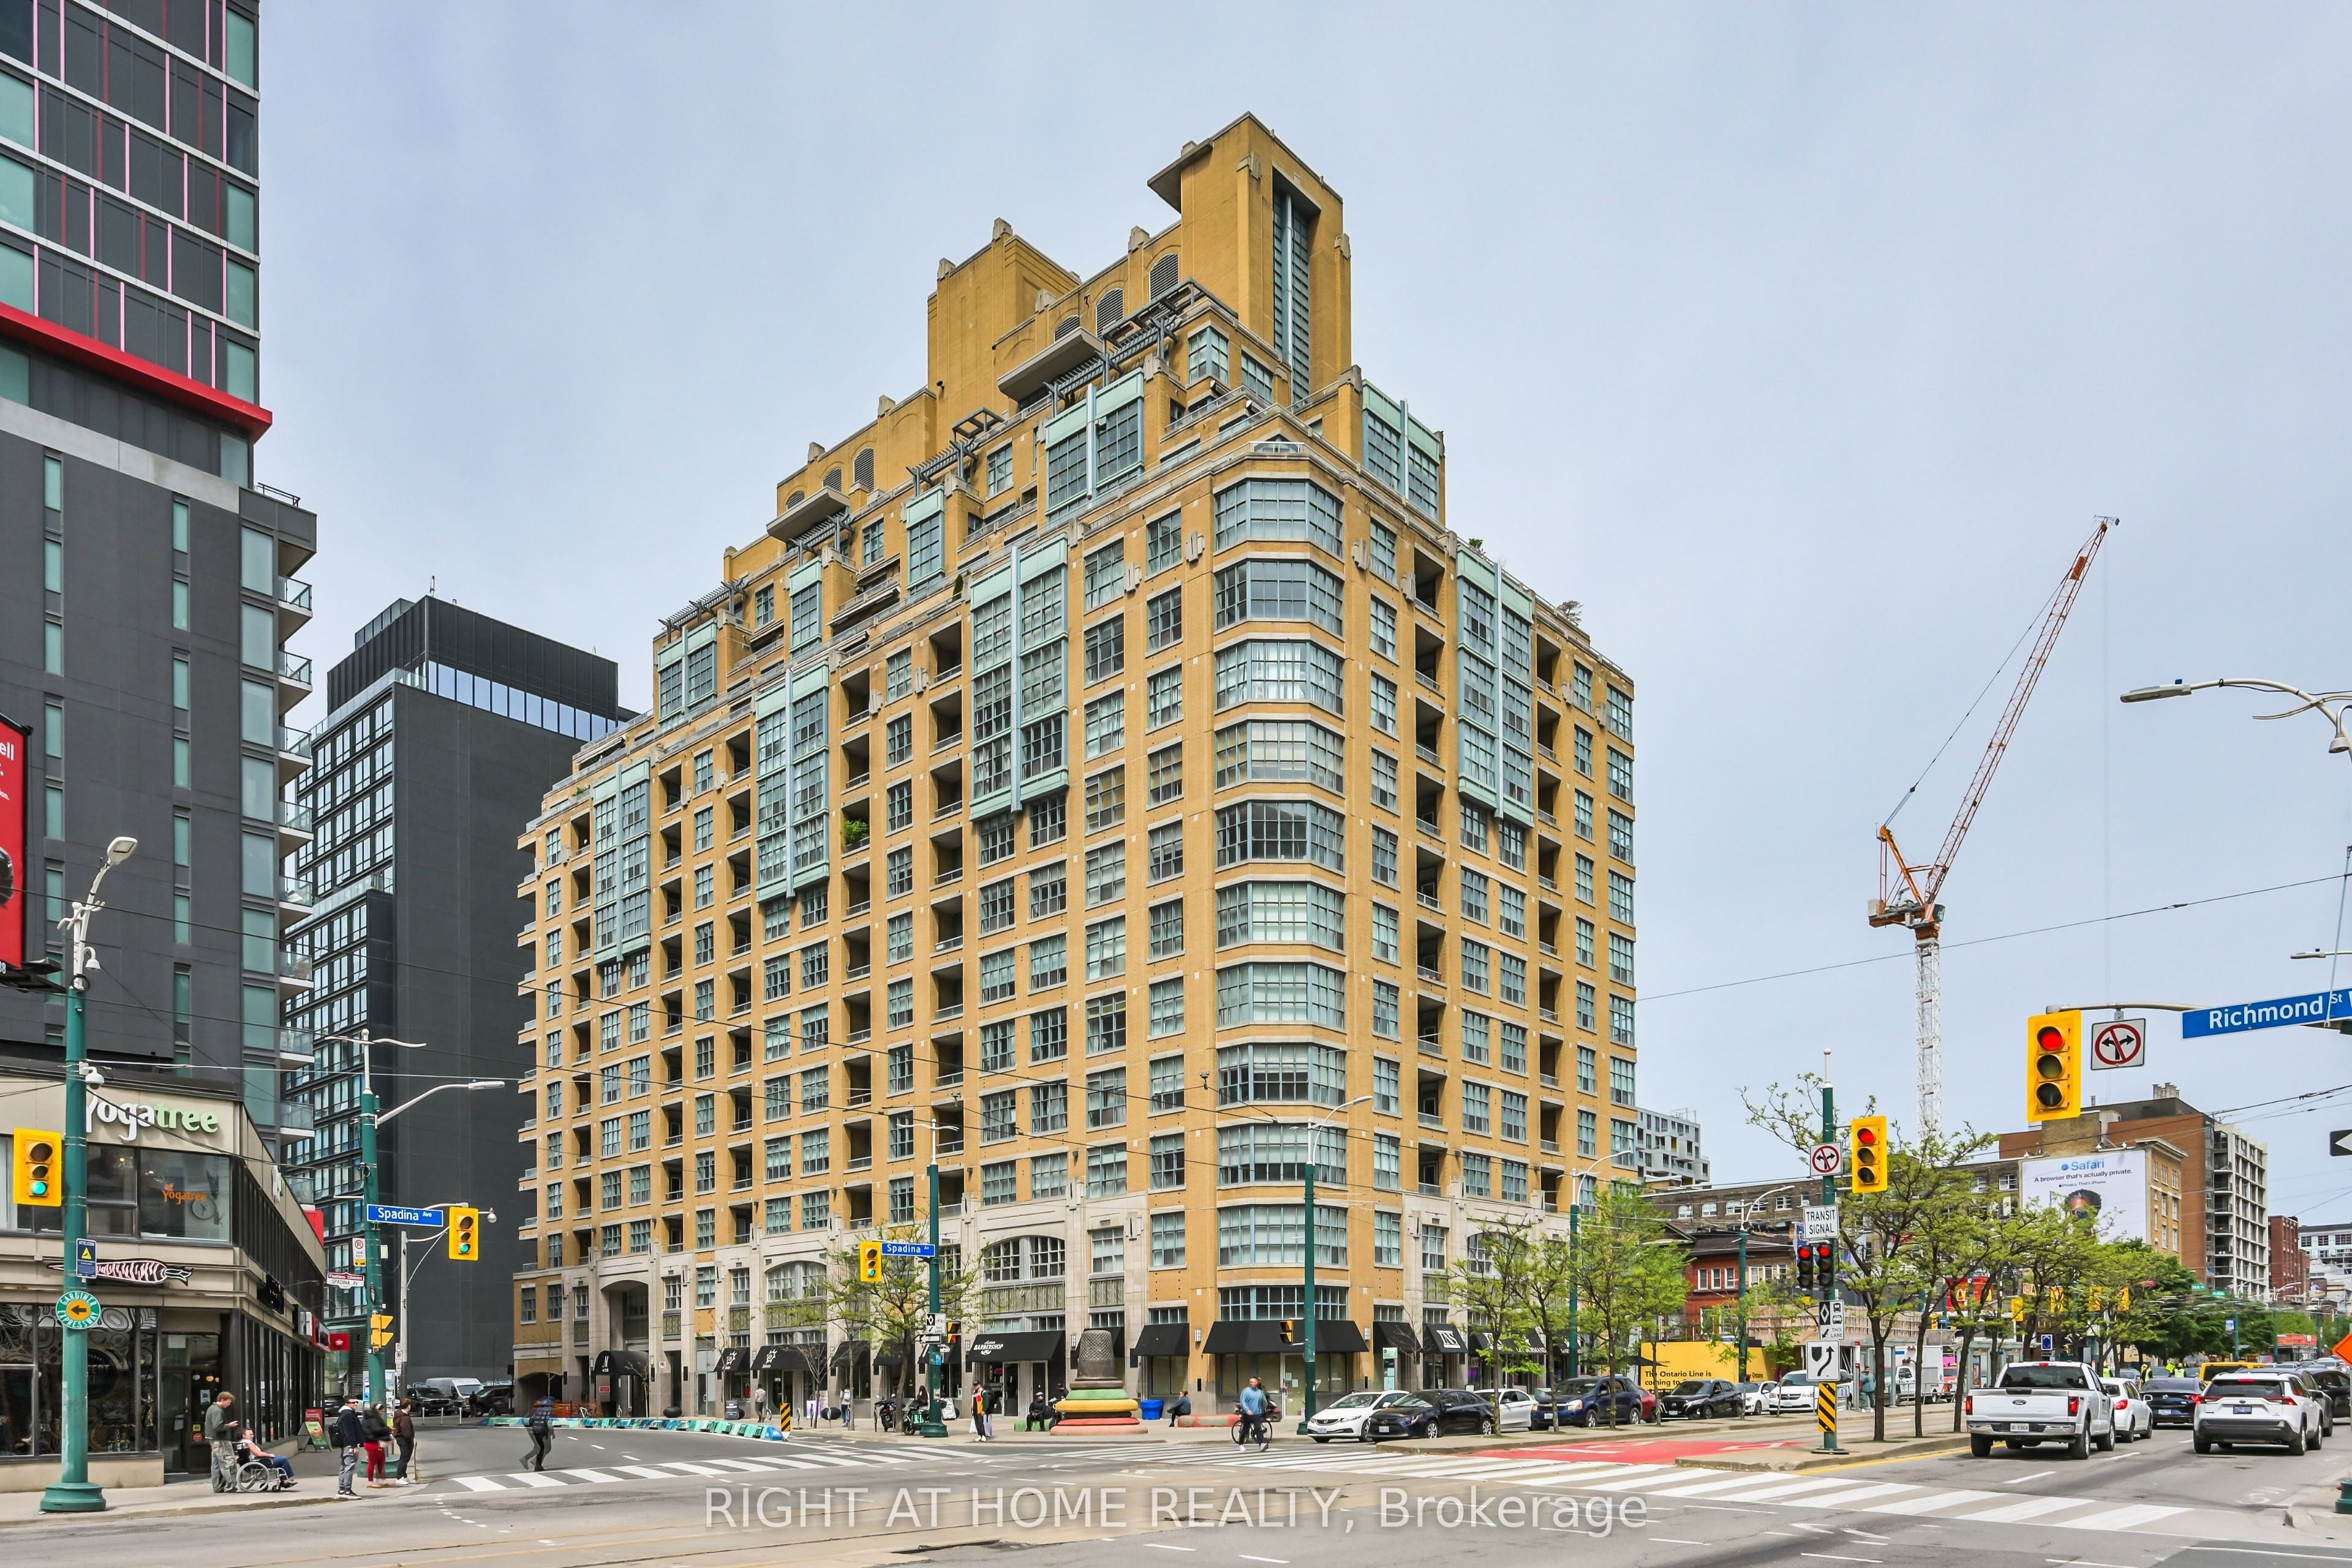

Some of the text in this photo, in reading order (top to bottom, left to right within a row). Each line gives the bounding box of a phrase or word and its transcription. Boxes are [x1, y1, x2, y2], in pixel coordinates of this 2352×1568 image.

[2209, 995, 2323, 1029] Richmond
[2331, 993, 2343, 1003] St
[2071, 1159, 2105, 1171] Safari
[378, 1207, 419, 1221] Spadina
[1806, 1210, 1836, 1222] TRANSIT
[1809, 1223, 1835, 1234] SIGNAL
[887, 1244, 921, 1254] Spadina
[59, 1292, 97, 1306] GARDINER
[57, 1310, 99, 1329] EXPRESSWAY
